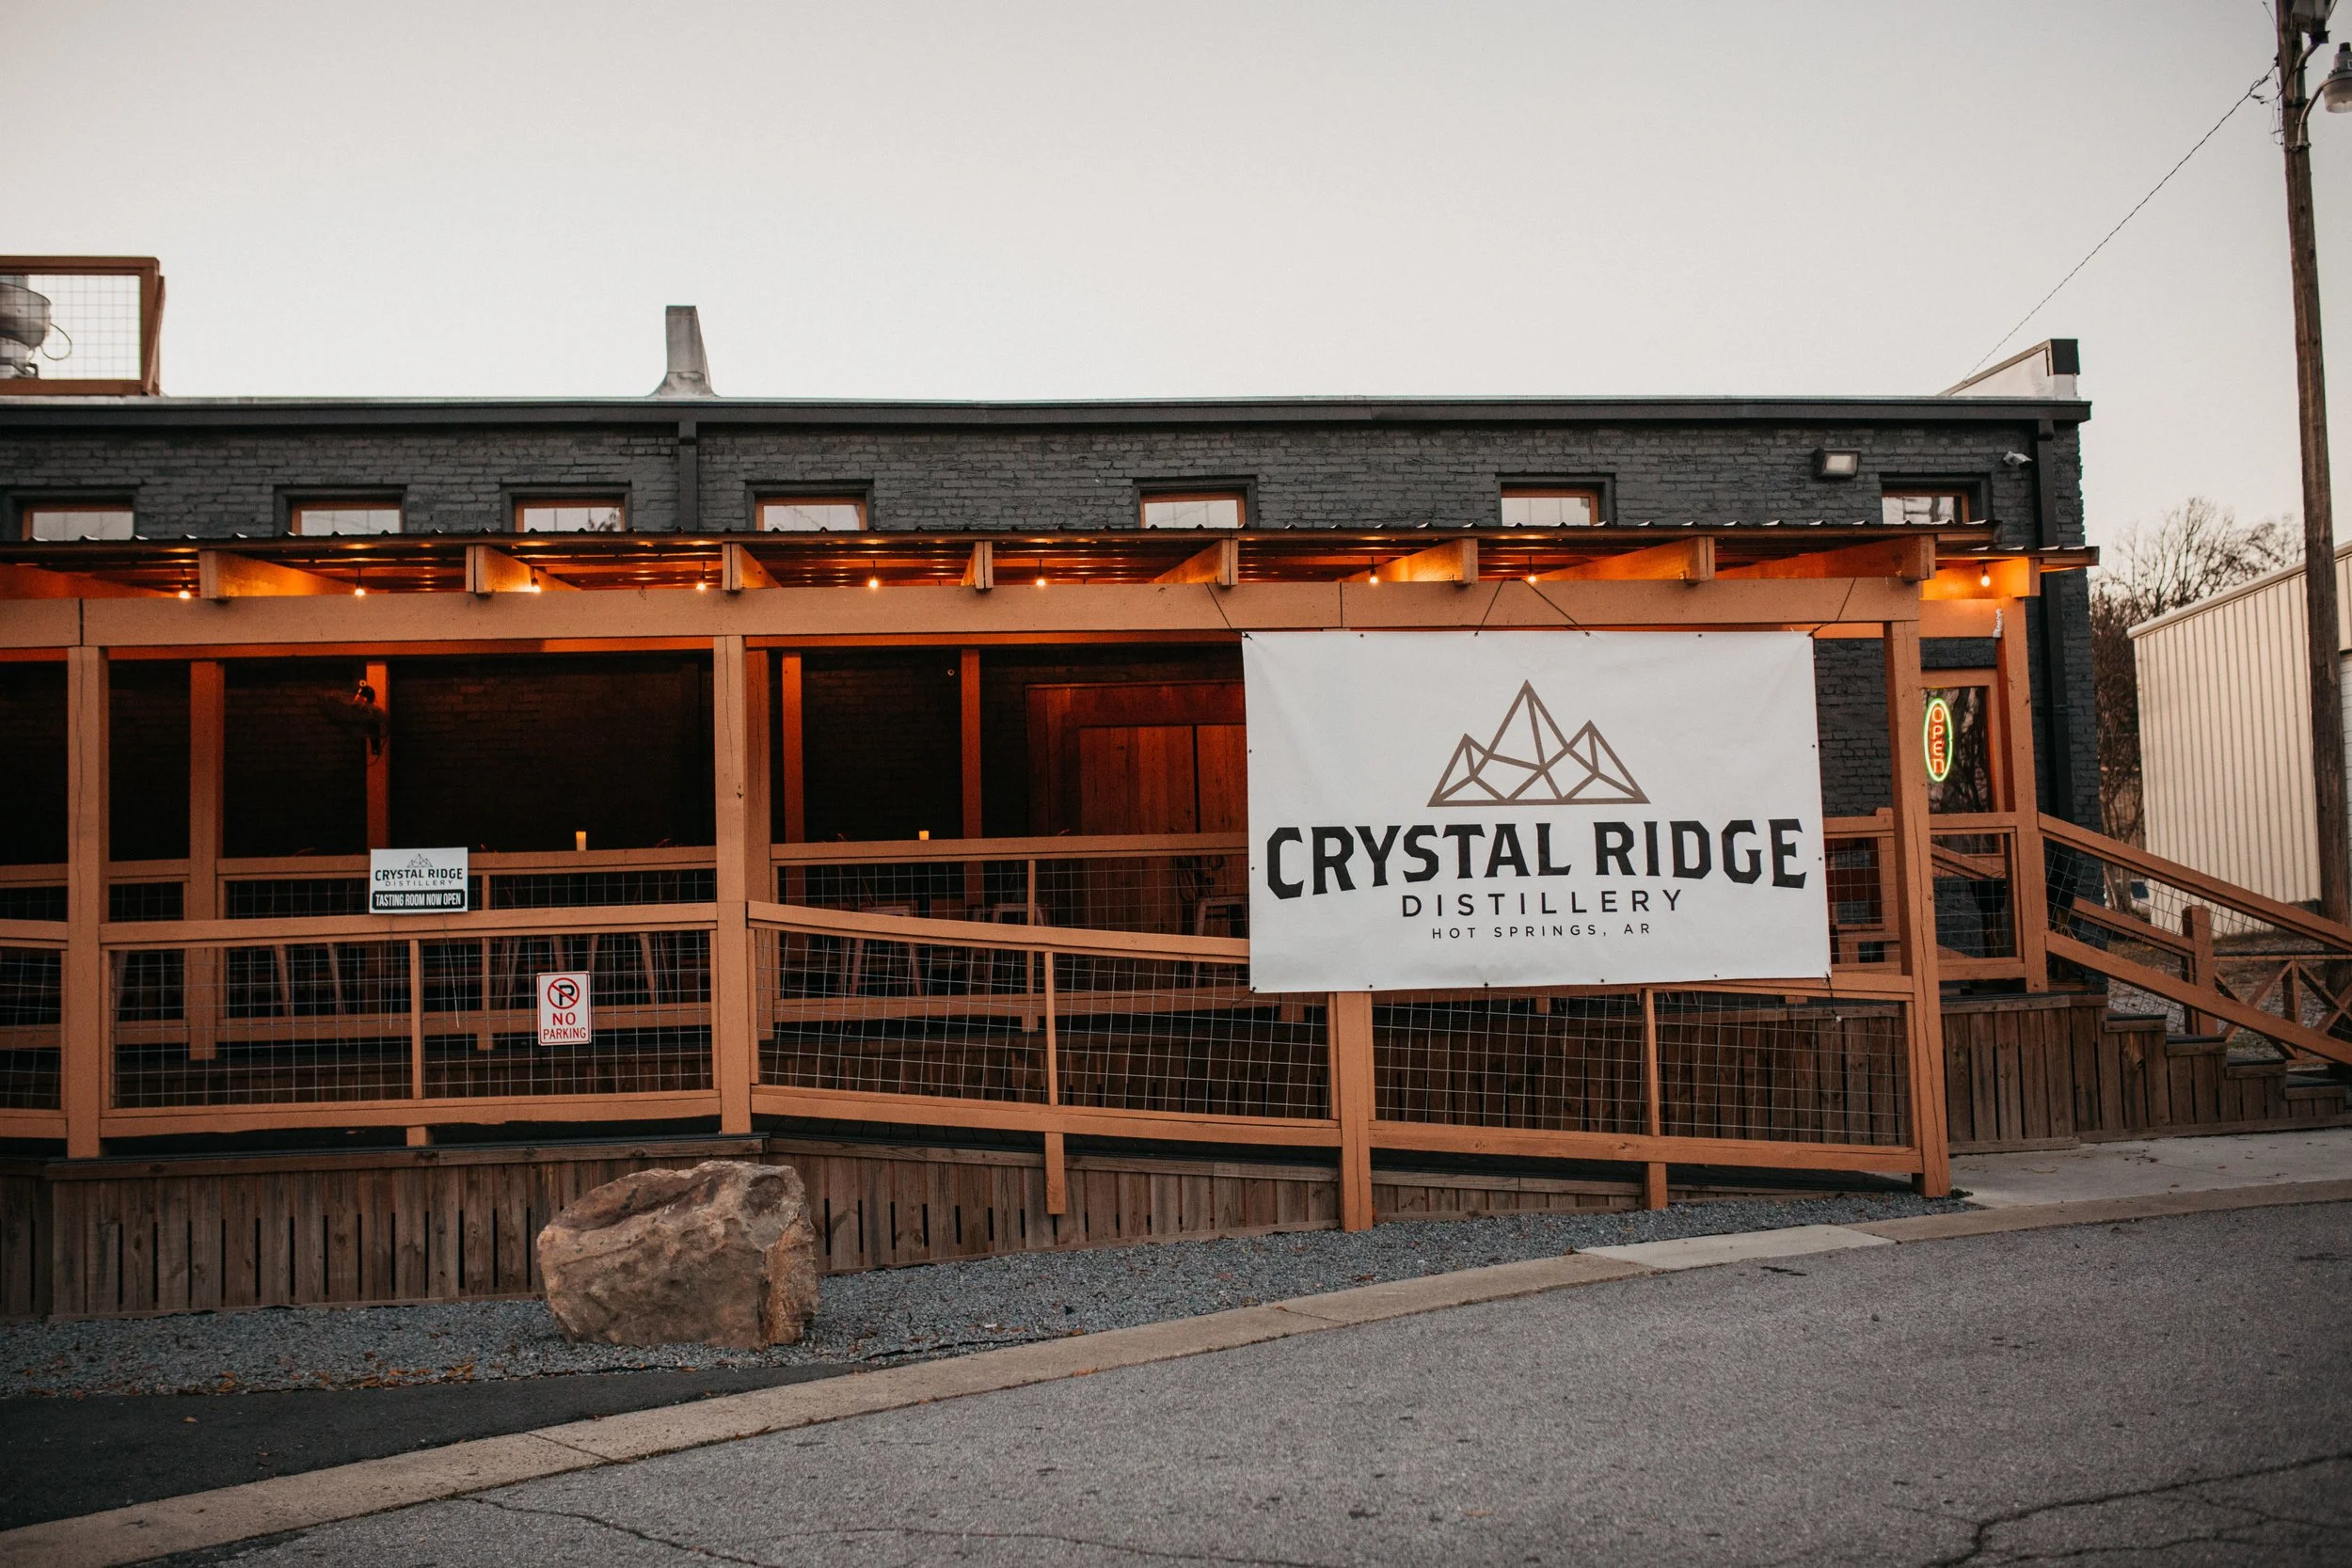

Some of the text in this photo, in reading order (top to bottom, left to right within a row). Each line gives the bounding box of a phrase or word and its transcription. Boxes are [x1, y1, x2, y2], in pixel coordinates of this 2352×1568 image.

[1932, 707, 1945, 773] OPEN
[1266, 818, 1807, 900] CRYSTAL RIDGE
[375, 868, 463, 880] CRYSTAL RIDGE
[375, 893, 461, 907] TASTING ROOM NOW OPEN
[1402, 890, 1682, 917] DISTILLERY
[1432, 924, 1651, 940] HOT SPRINGS, AR
[552, 1012, 576, 1025] NO
[543, 1027, 586, 1039] PARKING
